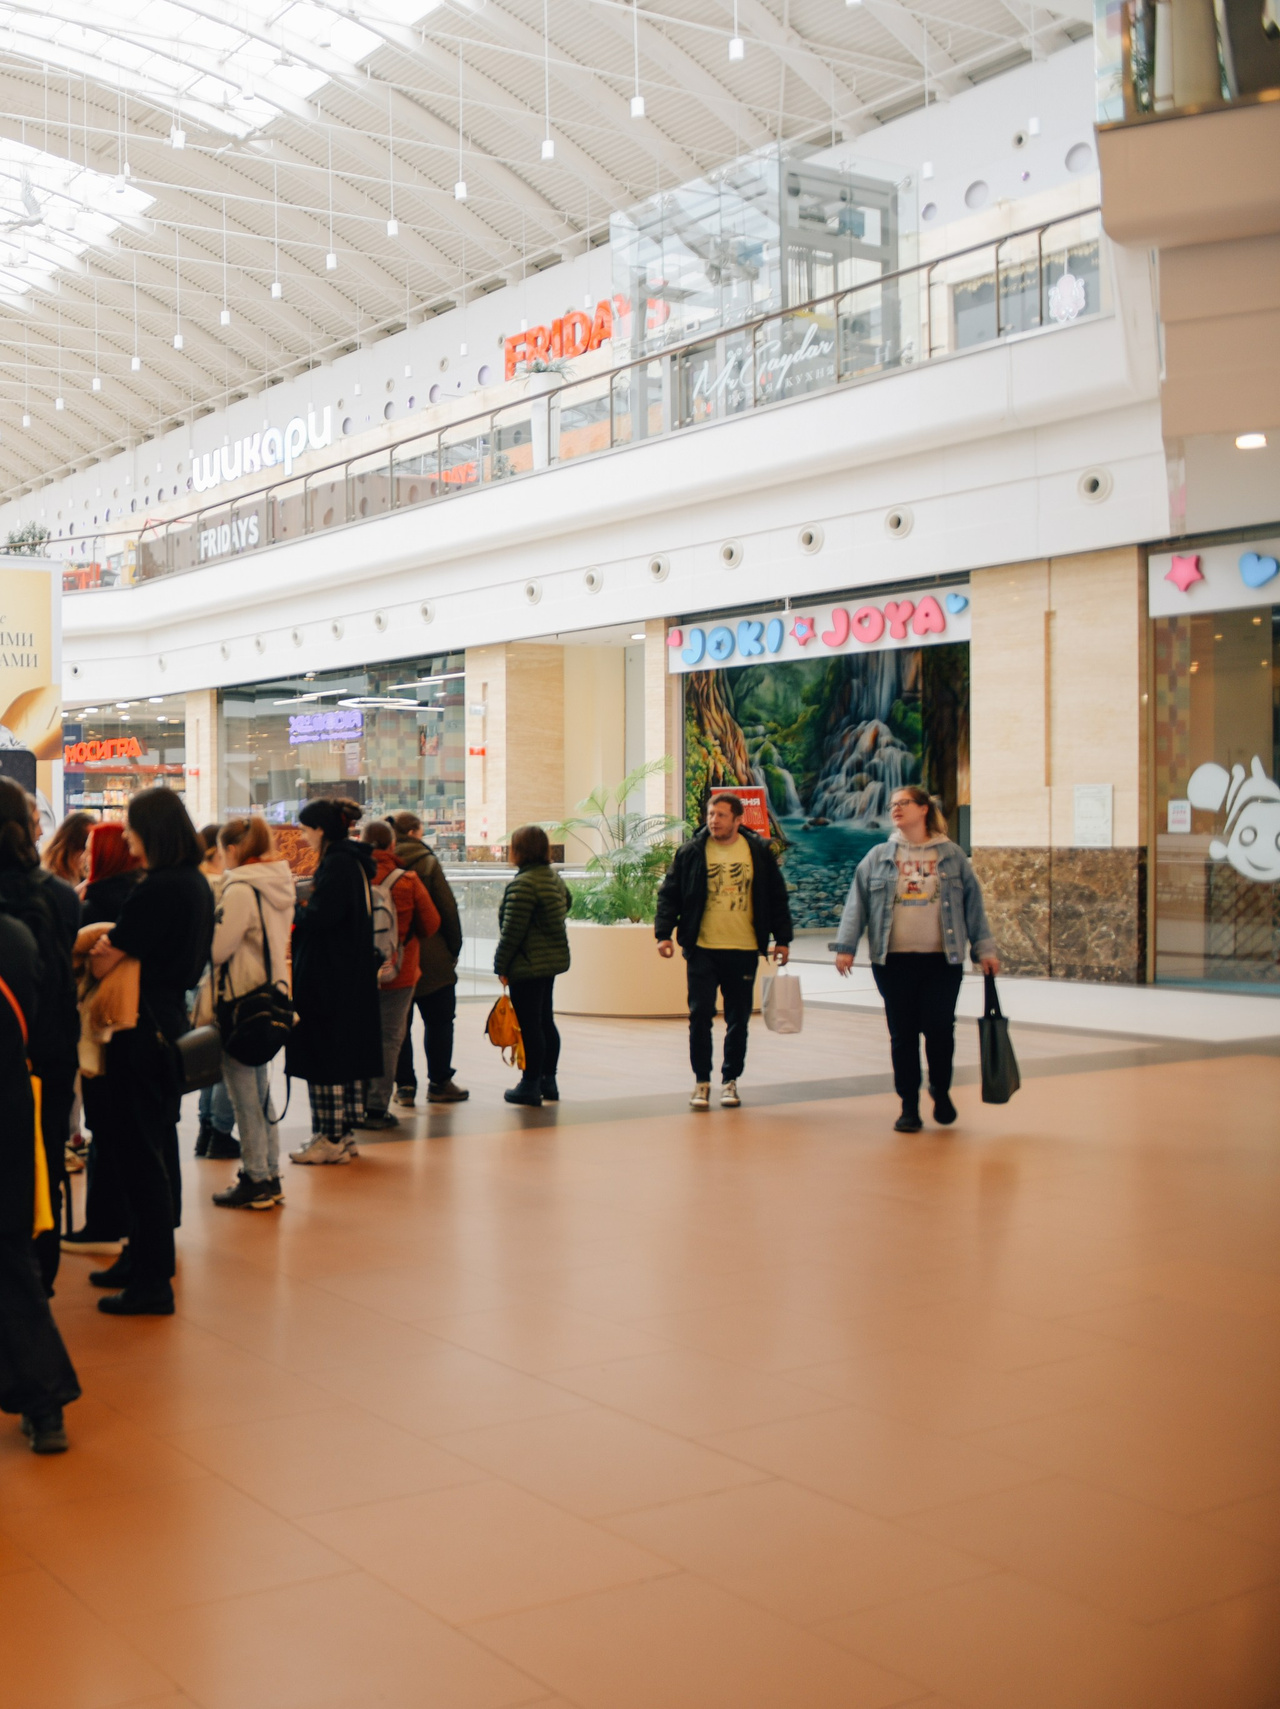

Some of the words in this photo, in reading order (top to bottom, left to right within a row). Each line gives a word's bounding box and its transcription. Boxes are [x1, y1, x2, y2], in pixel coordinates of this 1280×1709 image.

[200, 515, 259, 560] FRIDAYS
[0, 614, 7, 624] с
[681, 618, 784, 666] JOKI
[822, 595, 946, 647] JOYA
[65, 737, 142, 764] МОСИГРА
